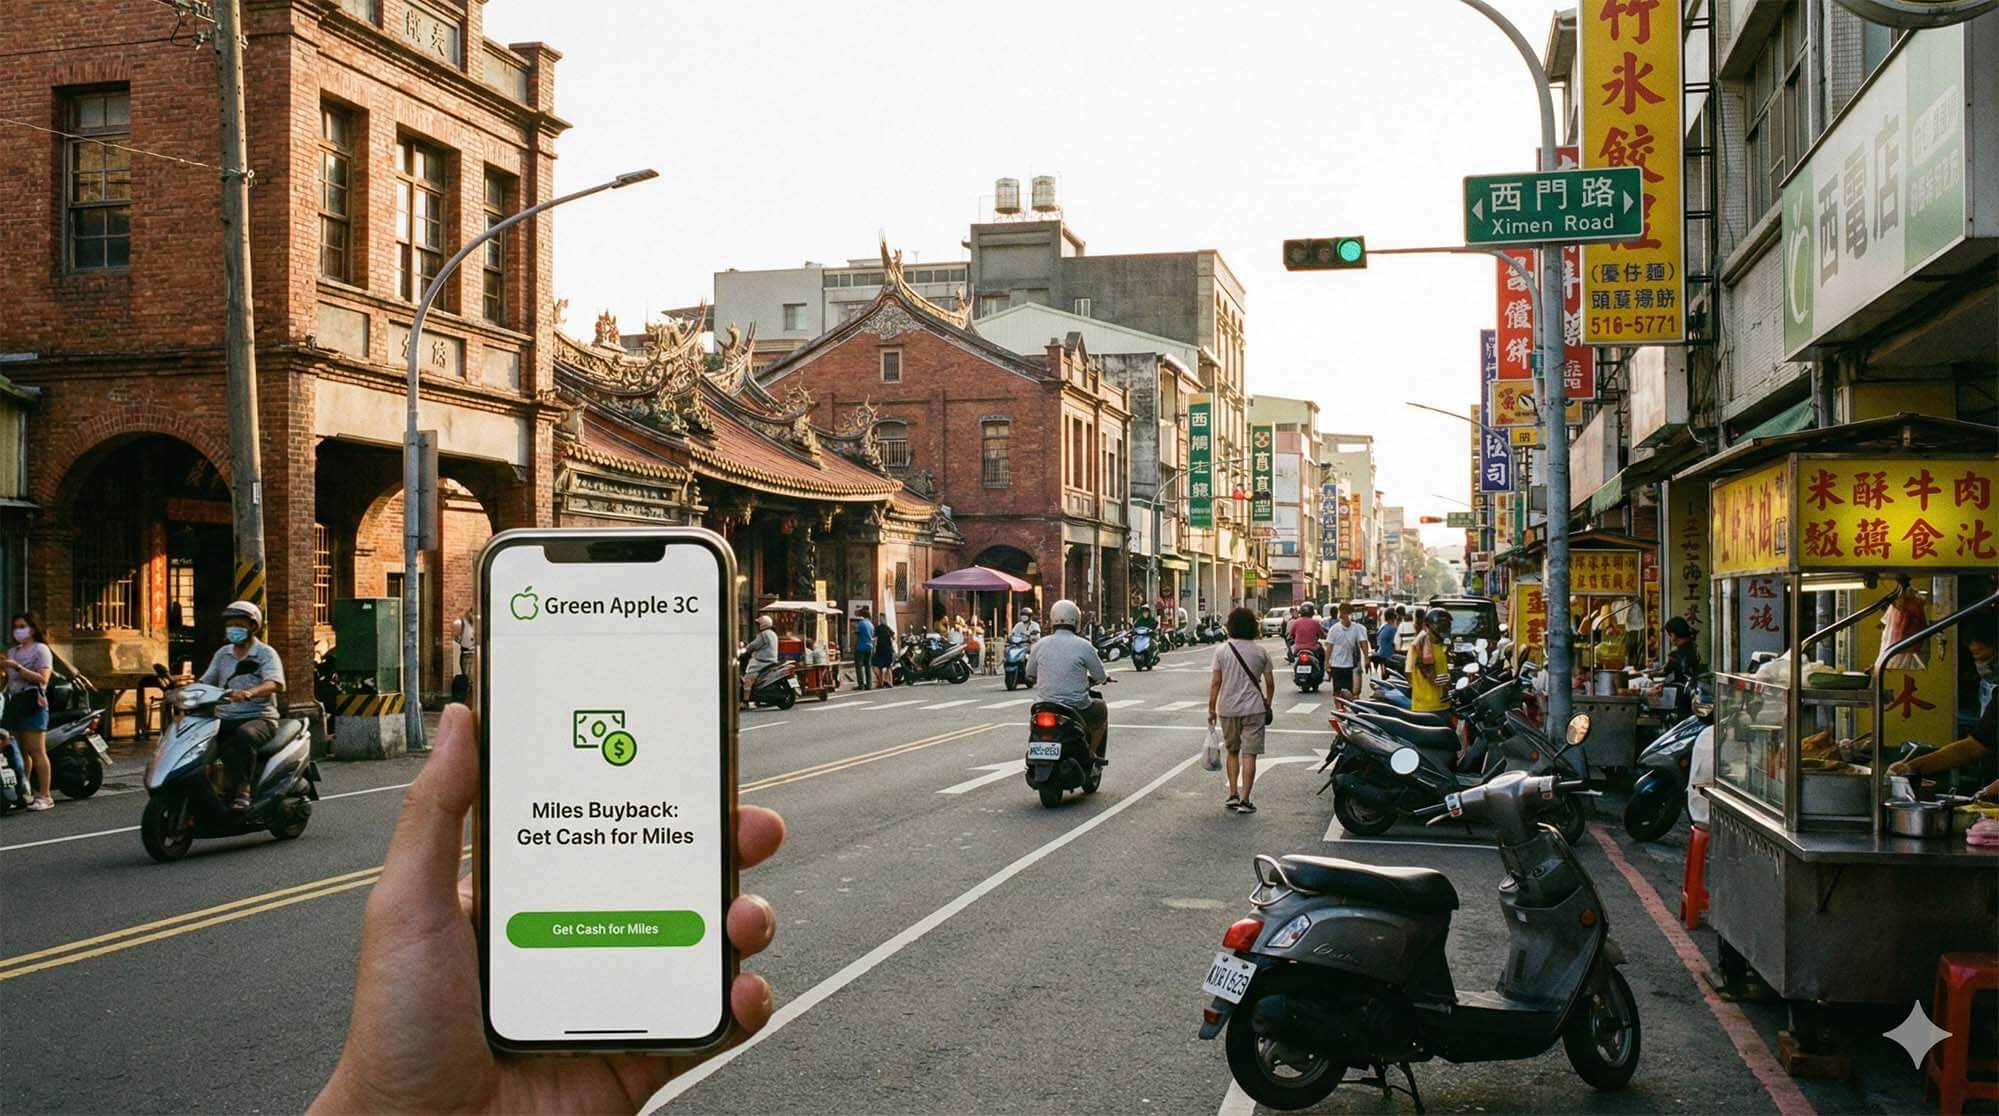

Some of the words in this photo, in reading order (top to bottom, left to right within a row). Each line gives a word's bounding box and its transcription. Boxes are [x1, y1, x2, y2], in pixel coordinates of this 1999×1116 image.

[1489, 176, 1615, 213] 西門路
[1491, 218, 1552, 236] Ximen
[1564, 213, 1614, 231] Road
[1591, 315, 1675, 335] 516-5771
[545, 597, 605, 614] Green
[610, 595, 668, 618] Apple
[673, 596, 699, 613] 3C
[532, 802, 583, 818] Miles
[589, 801, 679, 822] Buyback:
[517, 829, 551, 845] Get
[556, 828, 606, 845] Cash
[611, 828, 637, 844] for
[643, 827, 694, 844] Miles
[552, 924, 573, 935] Get
[576, 923, 606, 935] Cash
[608, 923, 625, 934] for
[628, 923, 659, 934] Miles
